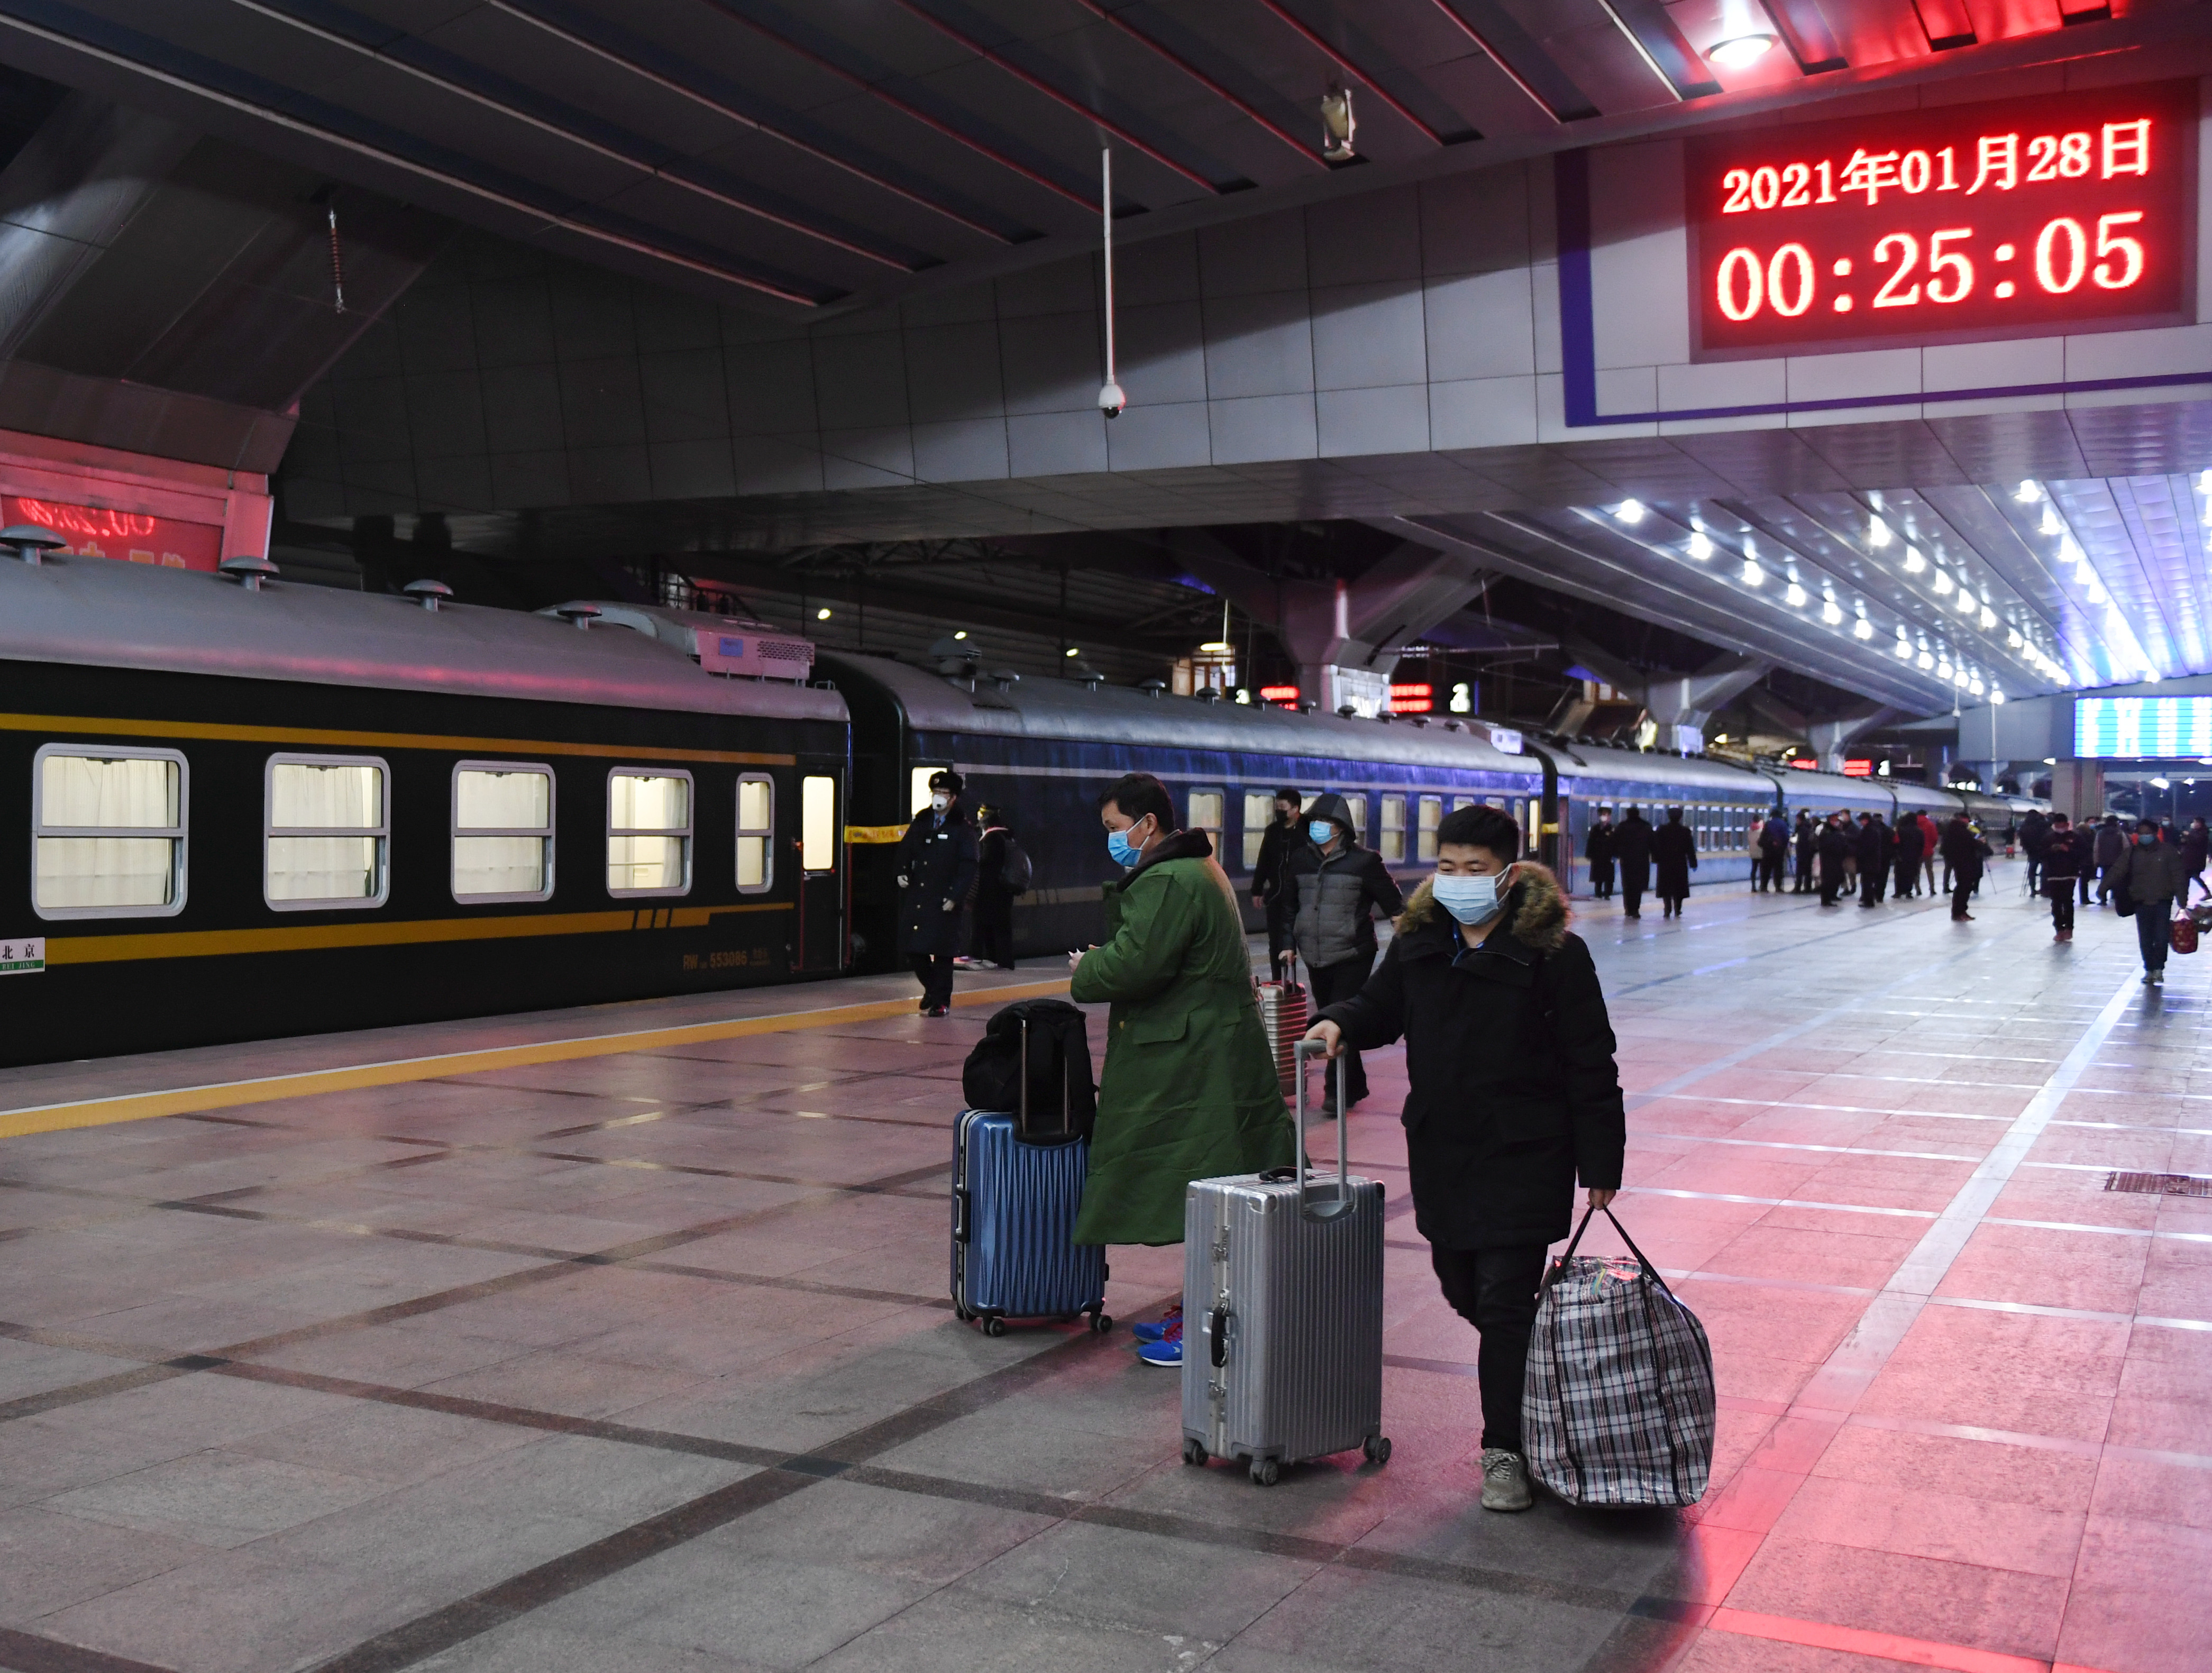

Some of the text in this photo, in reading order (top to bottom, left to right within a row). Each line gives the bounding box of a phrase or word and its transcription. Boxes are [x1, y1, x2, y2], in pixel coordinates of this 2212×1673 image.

[1722, 118, 2152, 213] 2021年01月28日
[1716, 211, 2144, 321] 00:25:05
[2, 944, 34, 959] 北京
